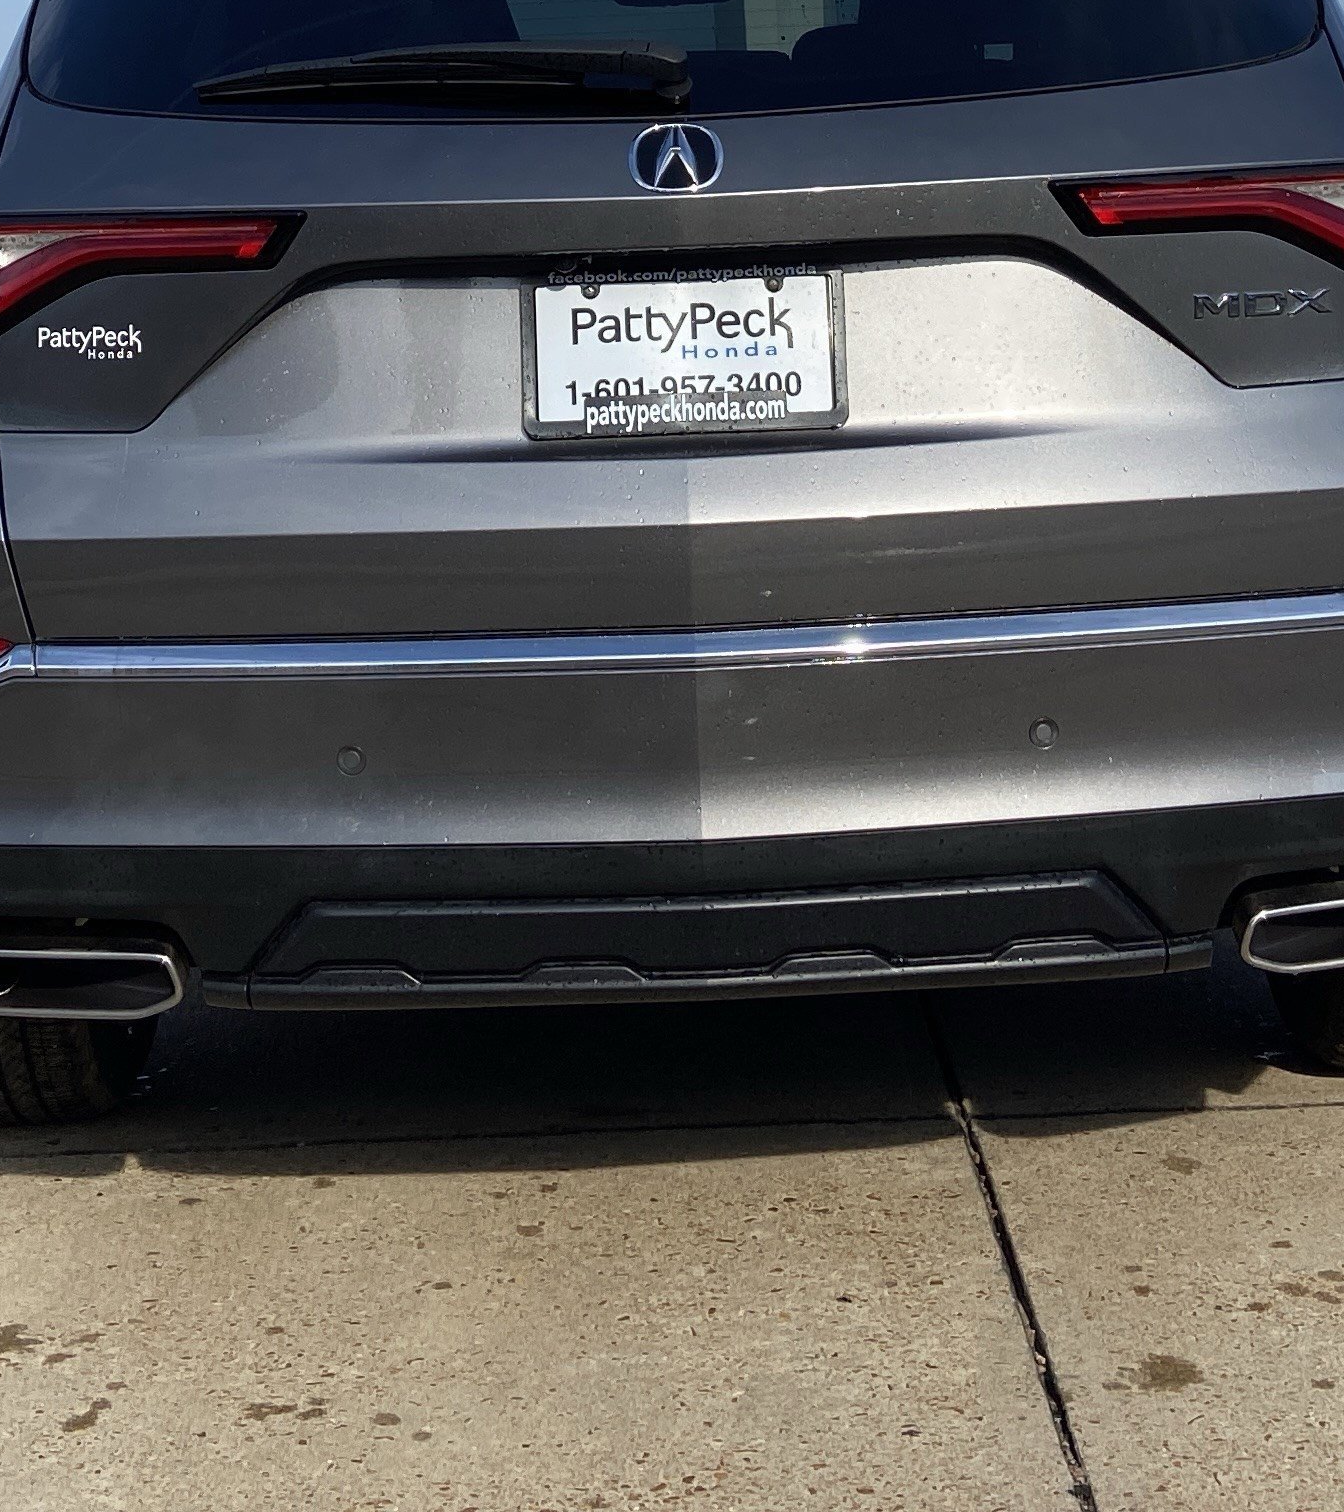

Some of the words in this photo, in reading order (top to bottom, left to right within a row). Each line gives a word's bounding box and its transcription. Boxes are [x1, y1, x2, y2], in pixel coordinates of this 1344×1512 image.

[548, 263, 817, 285] facebook.com/pattypeckhonda
[1193, 288, 1333, 320] MDX
[37, 324, 142, 354] PattyPeck
[570, 297, 794, 354] PattyPeck
[87, 348, 133, 359] Honda
[682, 341, 778, 359] Honda
[585, 393, 786, 434] pattypeckhonda.com
